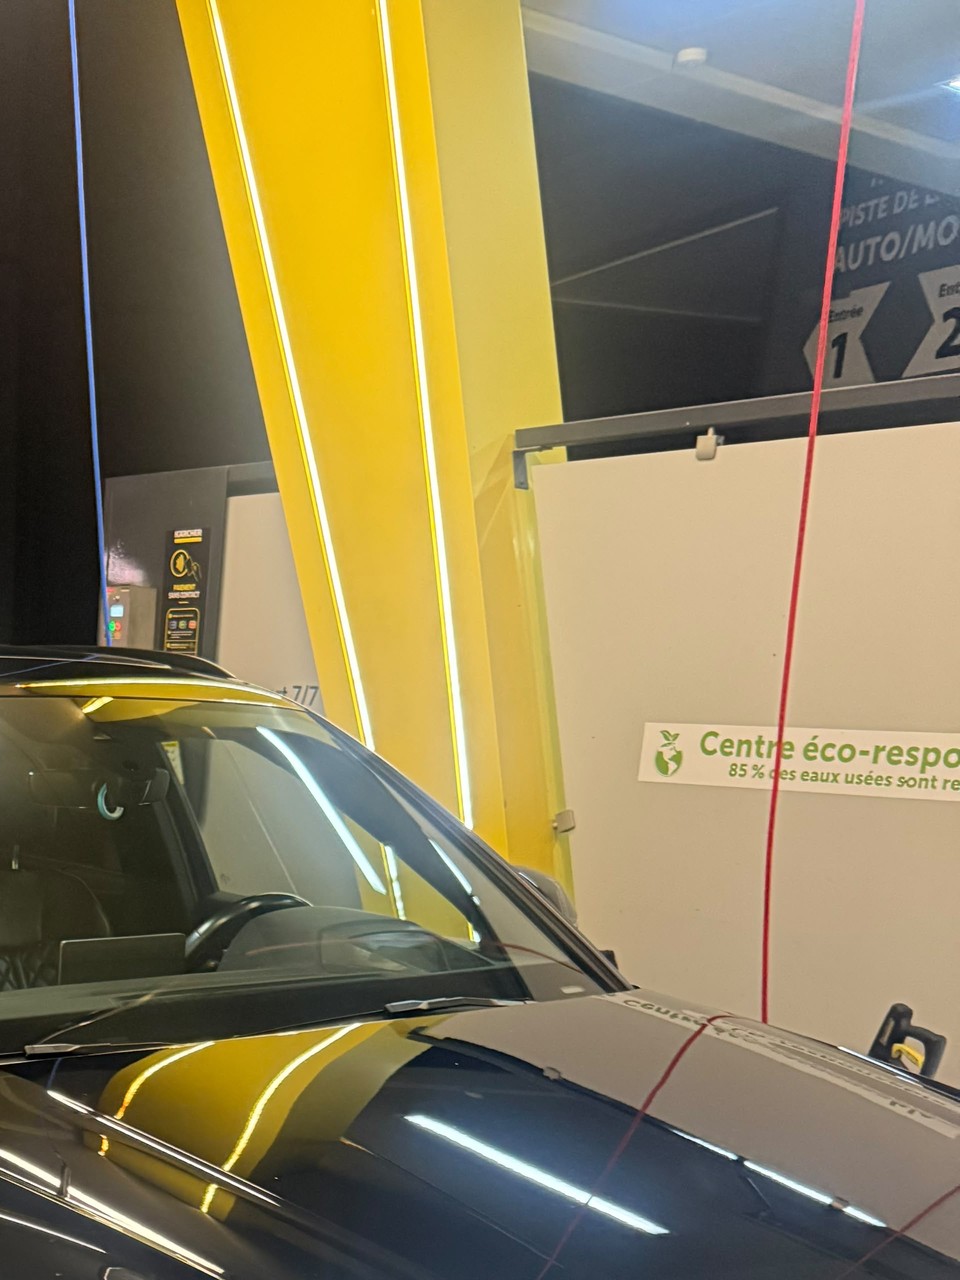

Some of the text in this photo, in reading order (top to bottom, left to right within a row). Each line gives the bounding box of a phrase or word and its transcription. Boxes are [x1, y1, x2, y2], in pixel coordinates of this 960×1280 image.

[893, 190, 919, 214] DE
[935, 306, 960, 359] 2
[831, 332, 848, 379] 1
[700, 731, 960, 774] Centre éco-respo
[729, 763, 748, 777] 85
[751, 764, 765, 778] %
[800, 771, 840, 784] eaux
[844, 771, 893, 787] usées
[896, 776, 937, 789] sont
